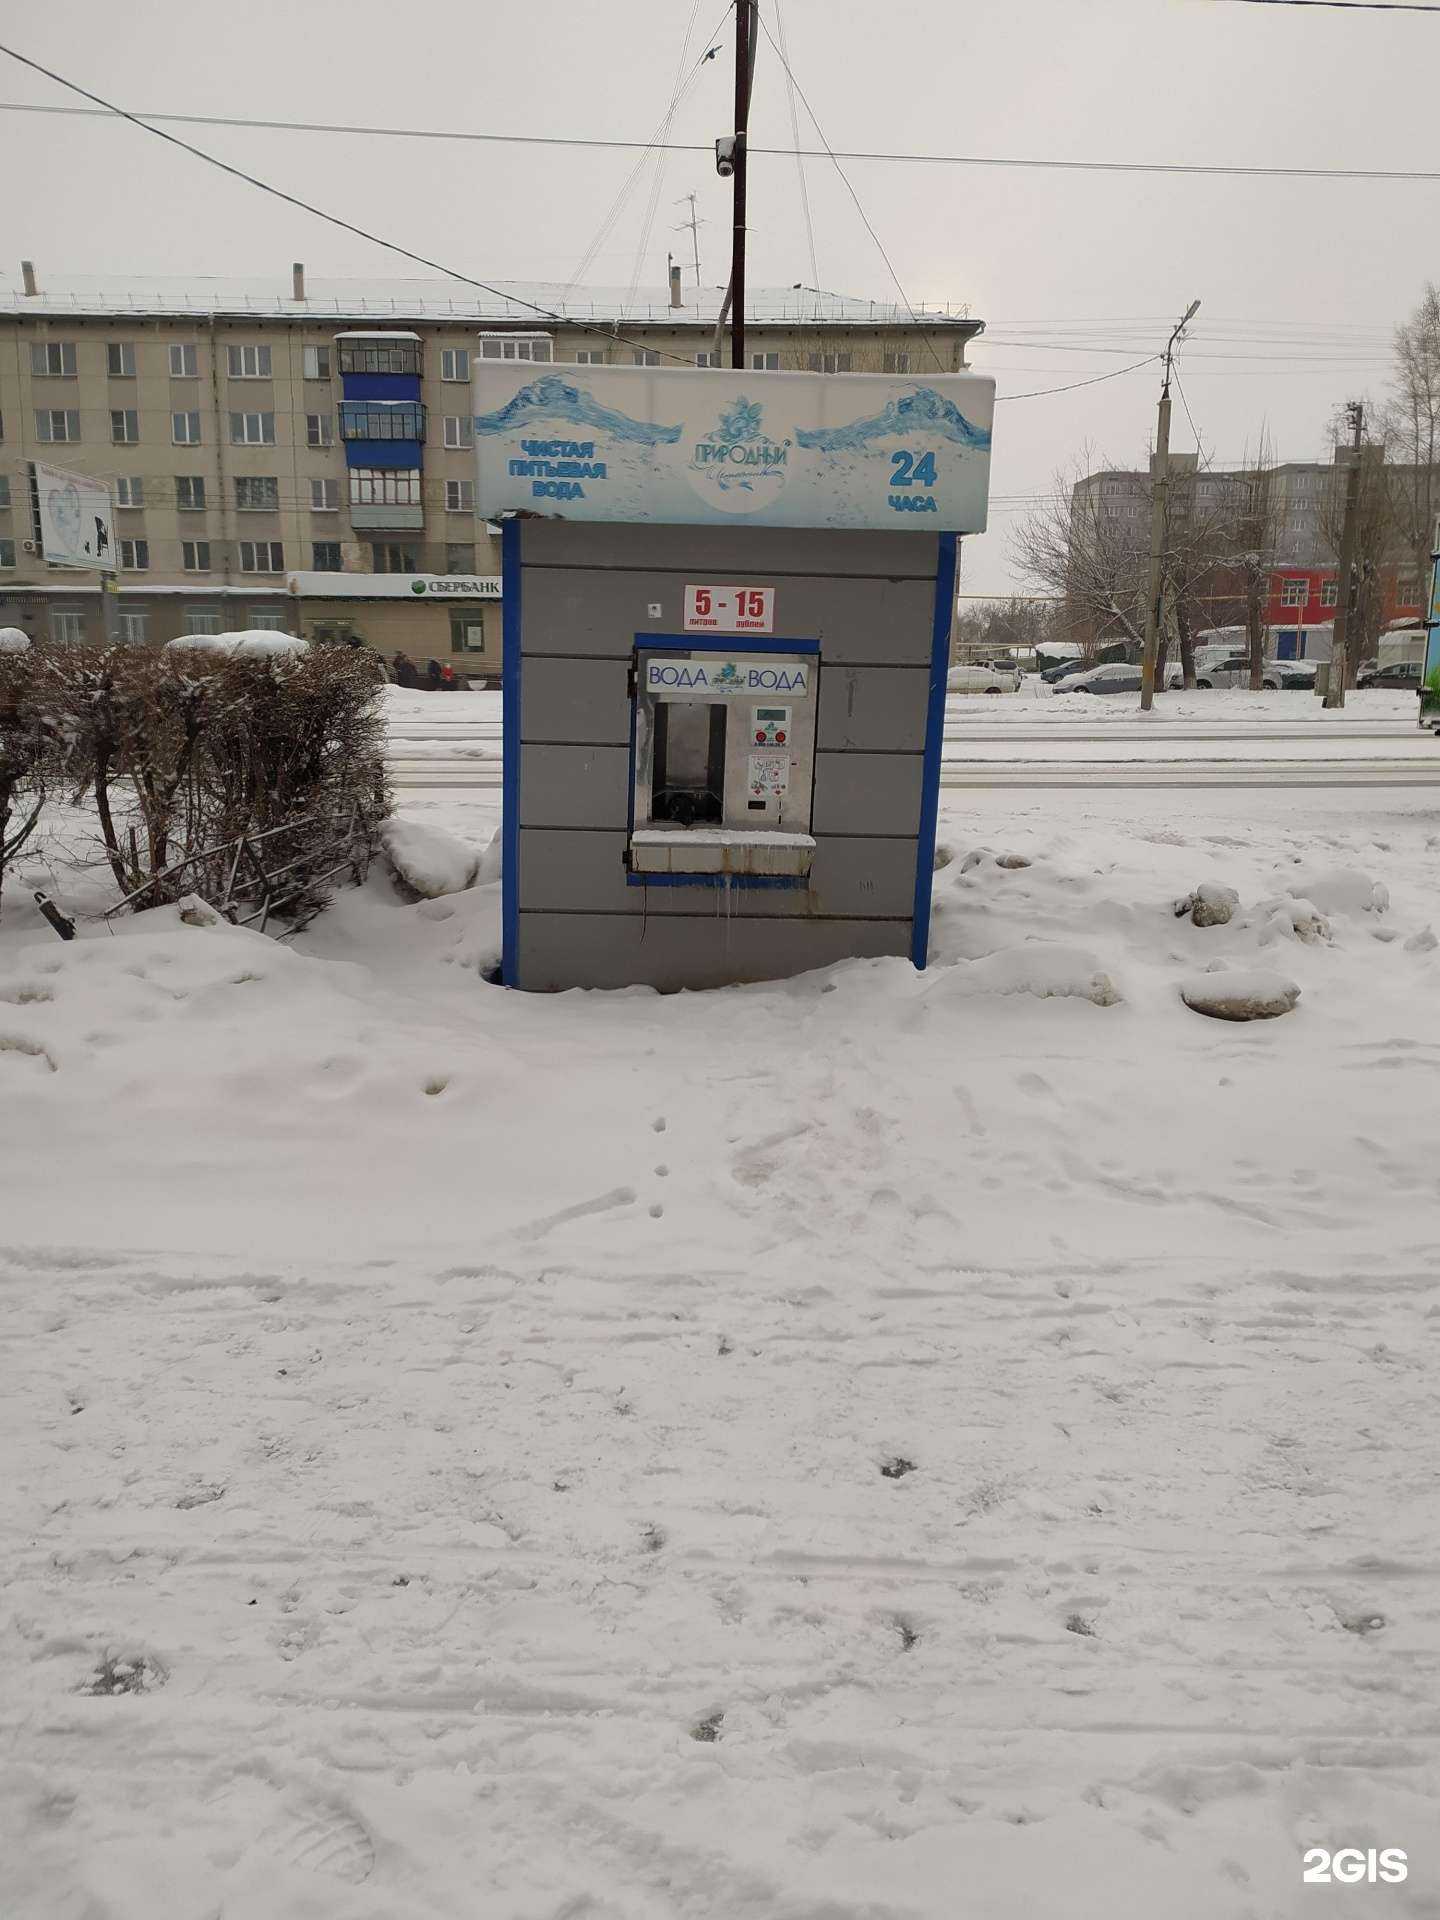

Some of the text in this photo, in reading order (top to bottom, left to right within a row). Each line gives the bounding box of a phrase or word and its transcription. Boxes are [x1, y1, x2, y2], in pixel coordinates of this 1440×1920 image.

[520, 439, 595, 459] ЧИСТАЯ
[508, 459, 608, 480] ПИТЬЕВАЯ
[889, 450, 938, 488] 24
[531, 480, 586, 501] ВОДА
[887, 495, 938, 513] ЧАСА
[429, 581, 500, 594] СБЕРБАНК
[695, 589, 711, 616] 5
[735, 591, 764, 617] 15
[649, 666, 708, 688] ВОДА
[748, 670, 806, 691] ВОДА
